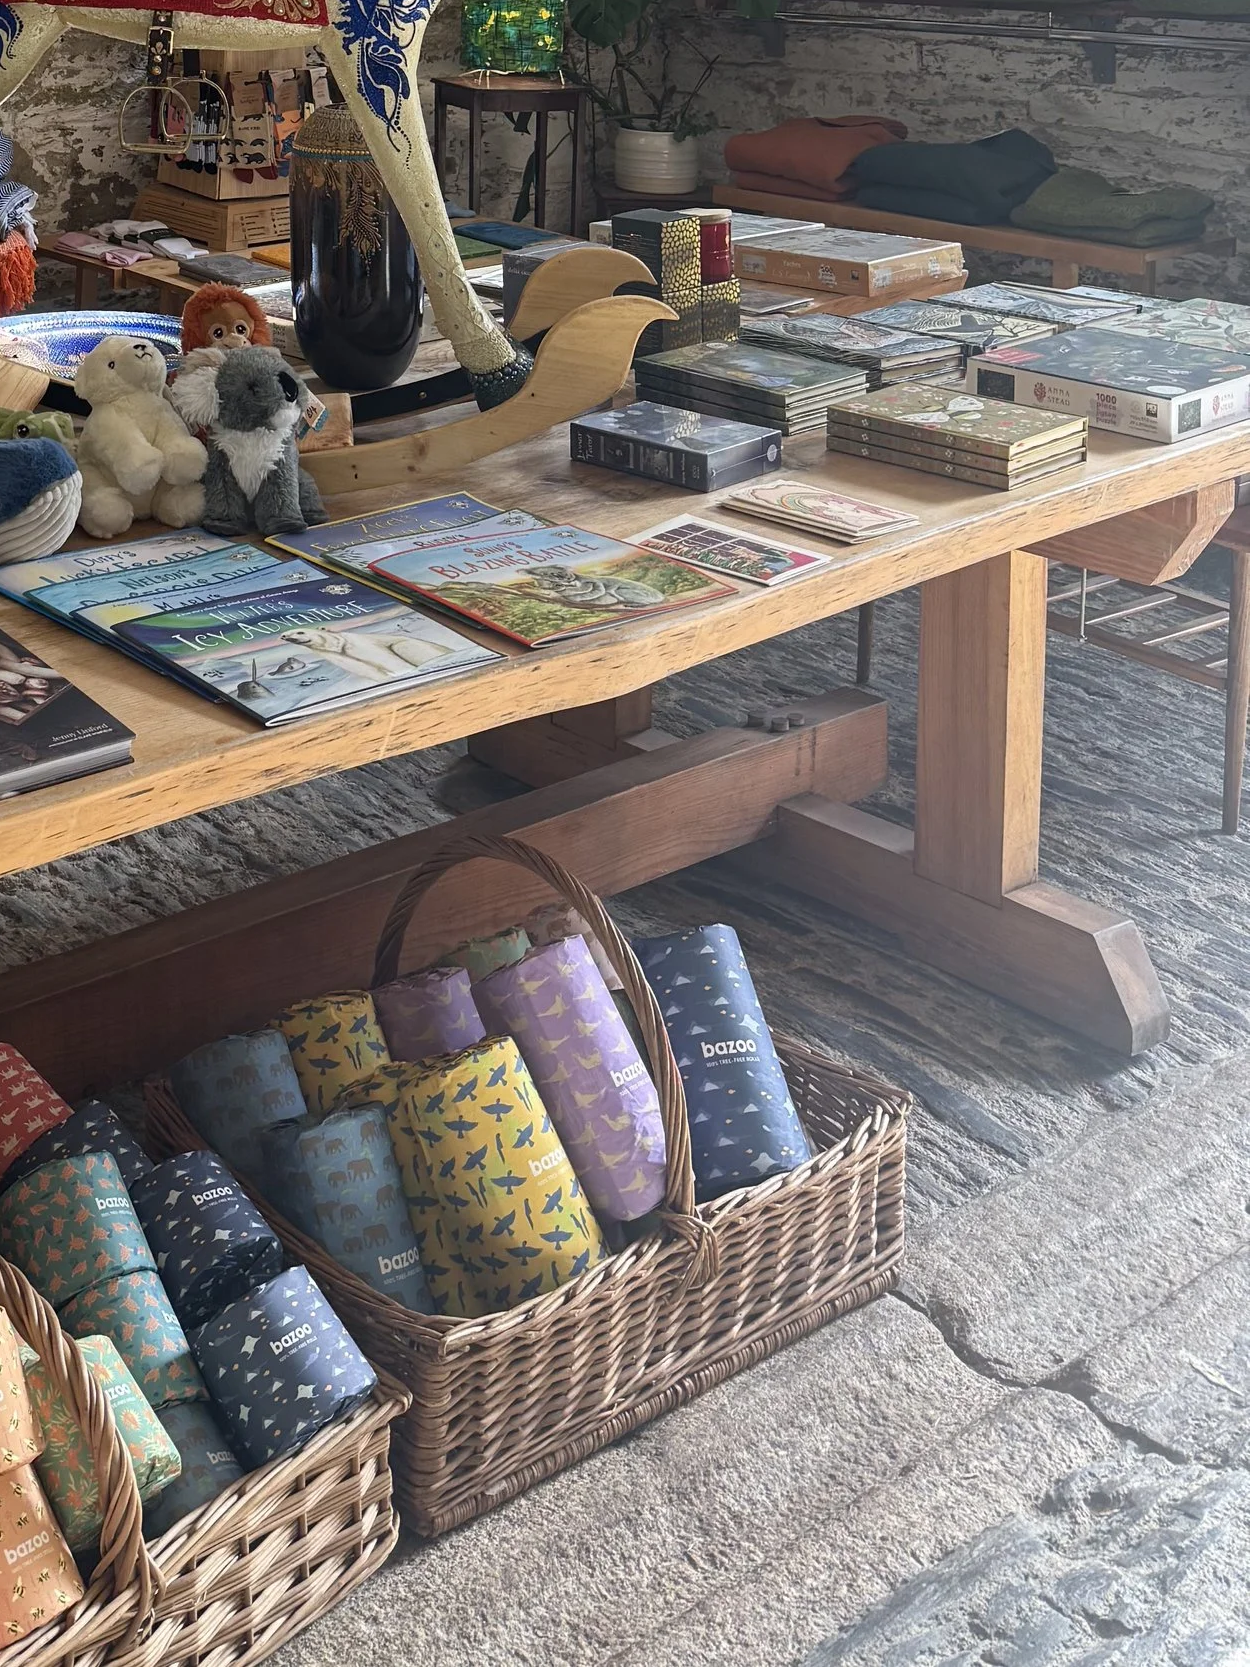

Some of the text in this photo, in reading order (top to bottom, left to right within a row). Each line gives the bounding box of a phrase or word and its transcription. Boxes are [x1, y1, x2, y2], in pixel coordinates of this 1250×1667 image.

[1047, 386, 1071, 397] ANNA
[1047, 396, 1071, 407] STEAD
[1096, 392, 1117, 405] 1000
[428, 540, 600, 580] BLAZING BATTLE
[121, 568, 198, 591] NELSON'S
[209, 599, 294, 625] HUNTER'S
[171, 630, 233, 652] ICY
[236, 600, 375, 641] ADVENTURE
[53, 731, 77, 742] Jenny
[701, 1039, 757, 1058] bazoo
[94, 1197, 130, 1211] bazoo
[191, 1186, 233, 1206] bazoo
[378, 1246, 420, 1275] bazoo
[269, 1323, 313, 1355] bazoo
[3, 1531, 50, 1565] bazoo
